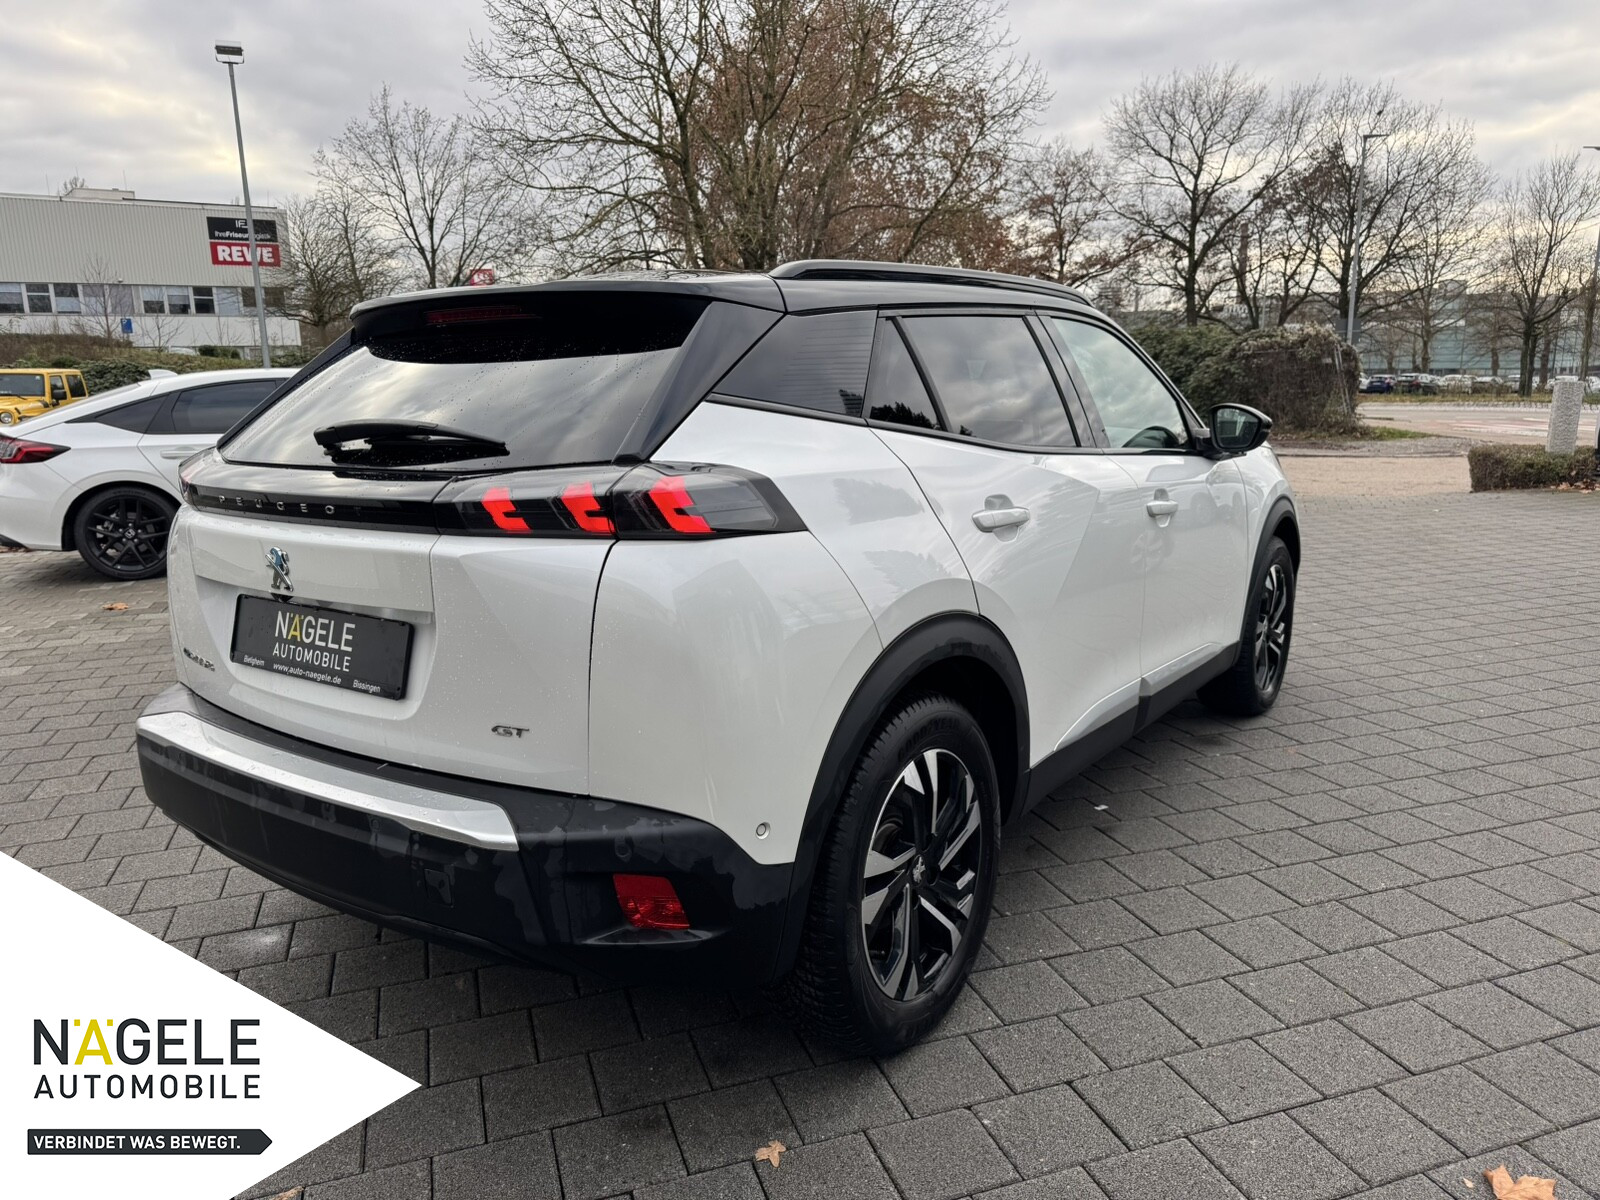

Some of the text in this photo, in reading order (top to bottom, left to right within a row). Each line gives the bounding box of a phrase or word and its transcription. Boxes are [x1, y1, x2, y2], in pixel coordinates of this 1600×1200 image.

[216, 245, 275, 263] REWE
[274, 610, 356, 652] NÄGELE
[272, 641, 352, 673] AUTOMOBILE
[273, 663, 342, 685] www.auto-naegele.de
[352, 679, 381, 694] Bissingen
[491, 725, 530, 738] GT
